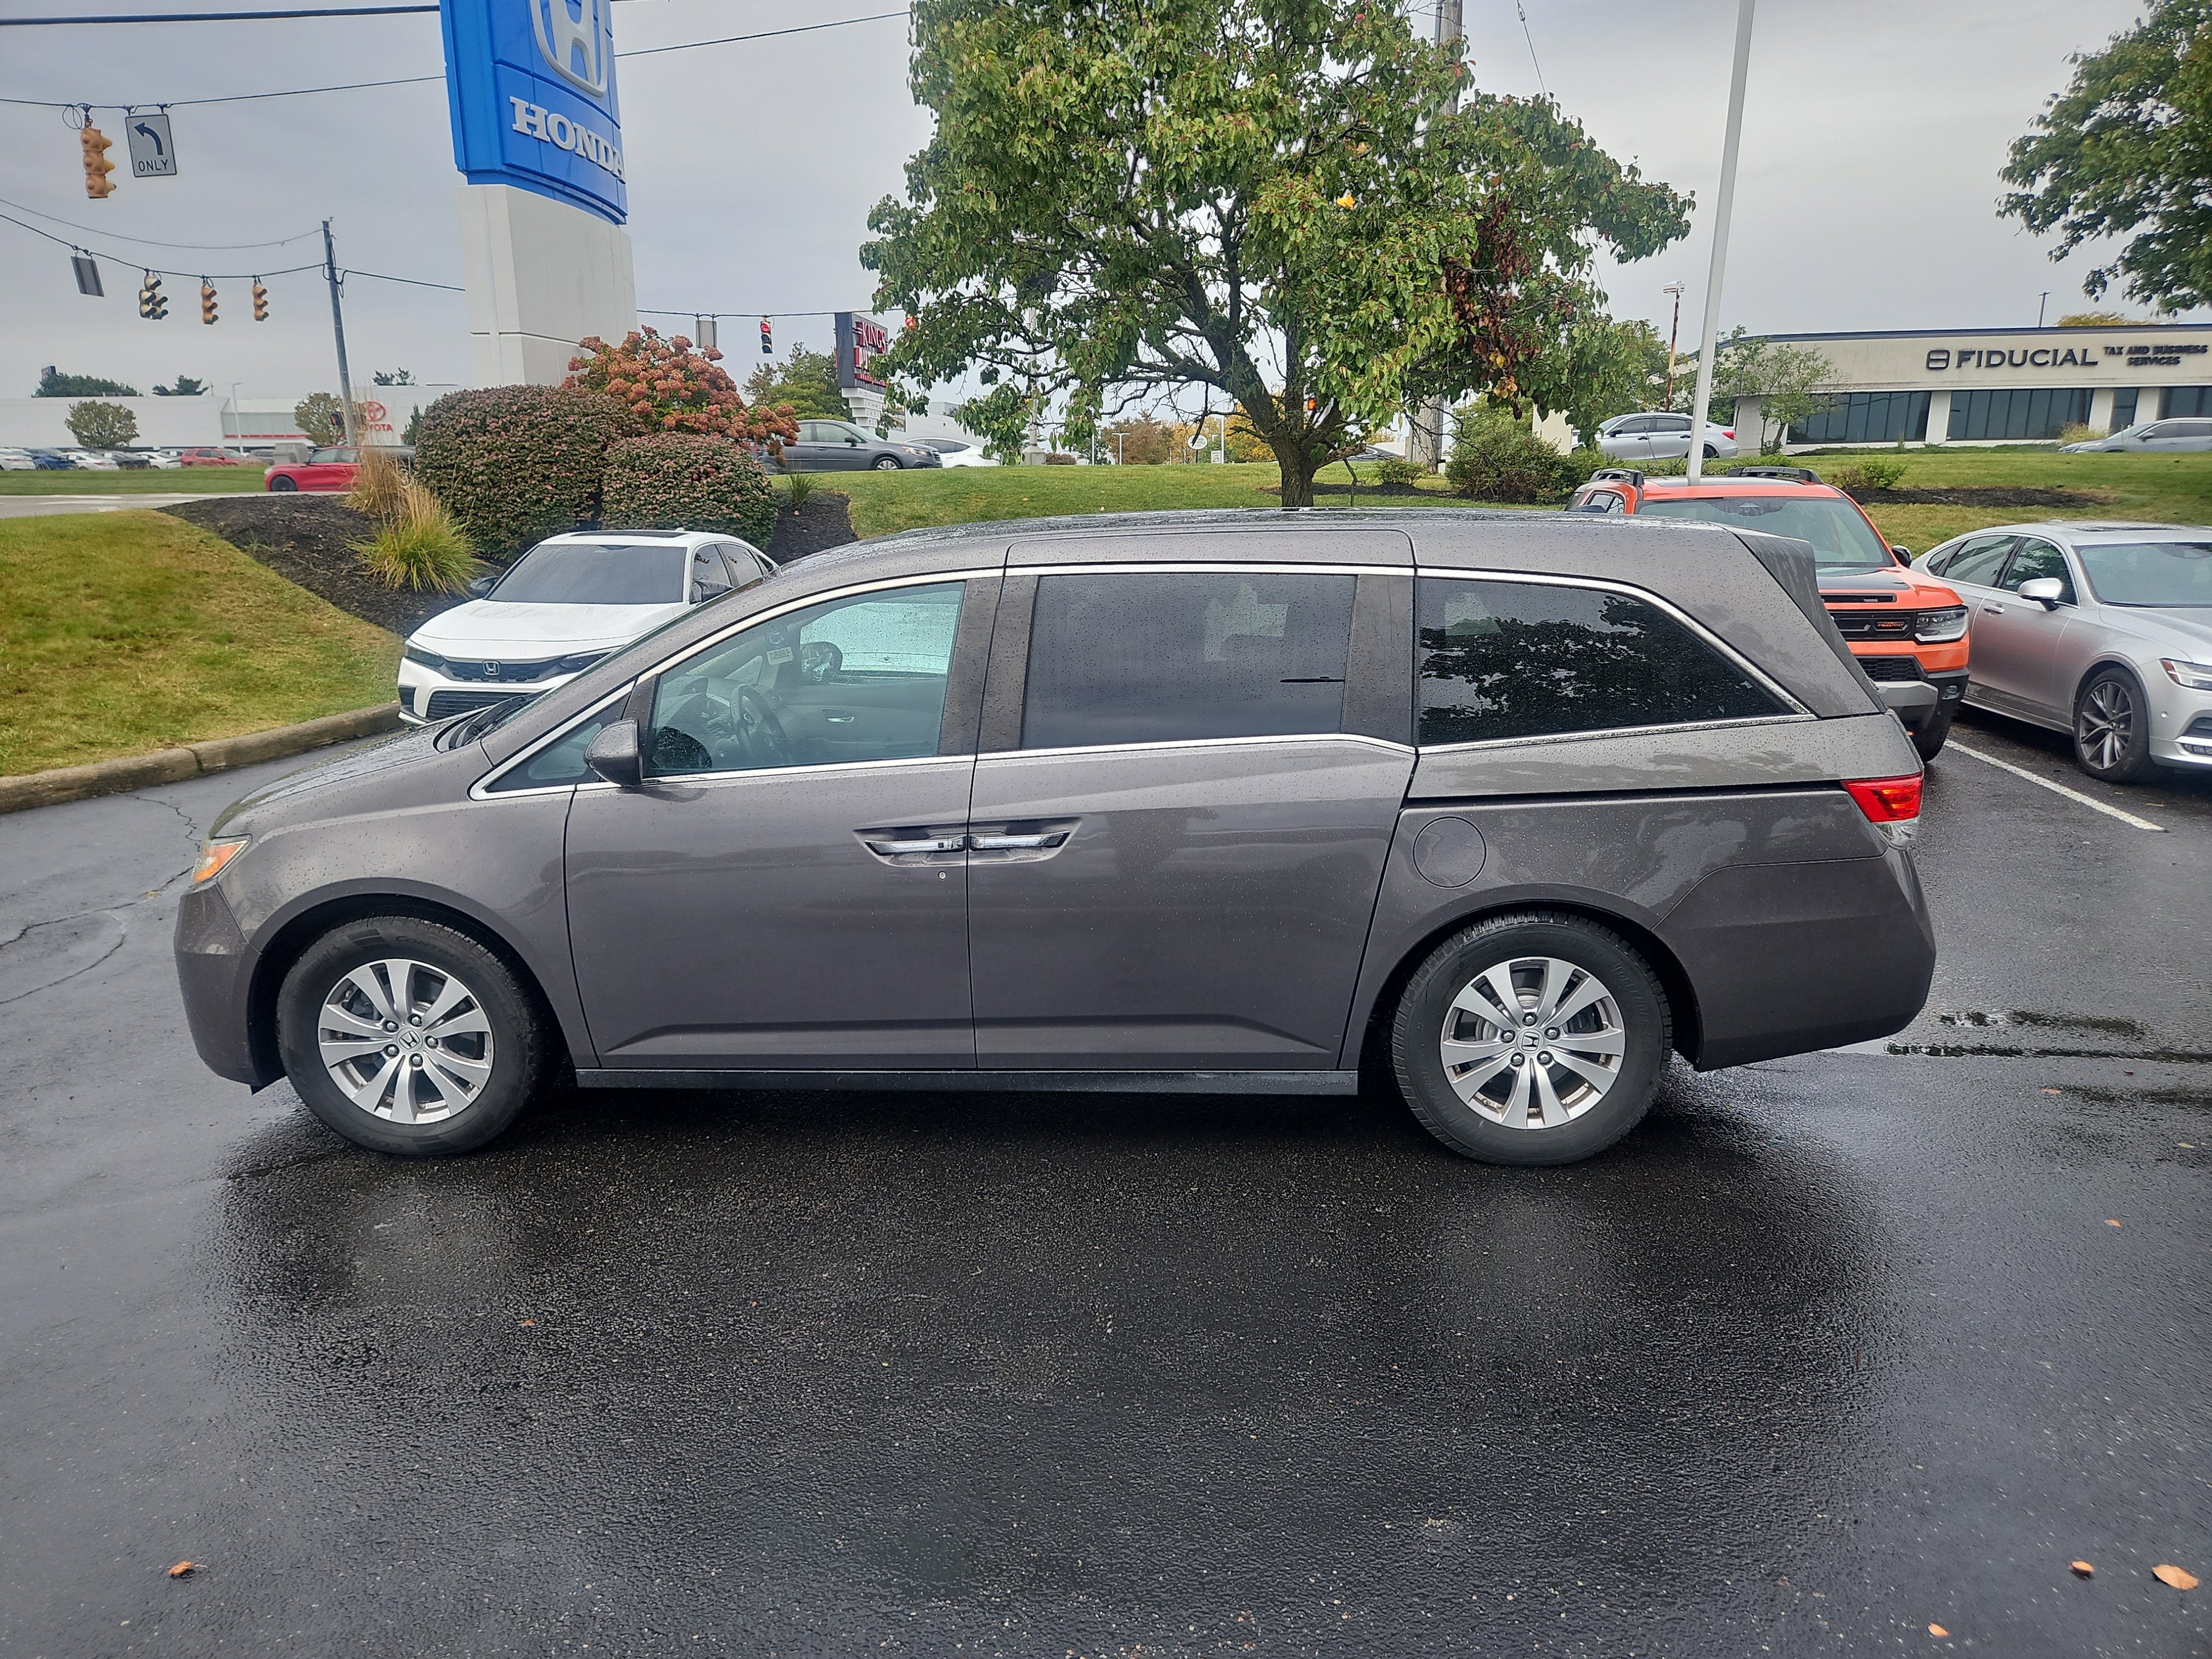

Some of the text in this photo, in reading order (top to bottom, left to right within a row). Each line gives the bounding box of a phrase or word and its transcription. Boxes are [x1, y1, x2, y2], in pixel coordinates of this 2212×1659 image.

[510, 97, 625, 184] HONDA
[138, 159, 168, 172] ONLY
[861, 321, 886, 354] KINGS
[1955, 348, 2098, 368] FIDUCIAL
[2103, 346, 2125, 356] TAX
[2126, 346, 2150, 355] AND
[2126, 356, 2181, 366] SERVICES
